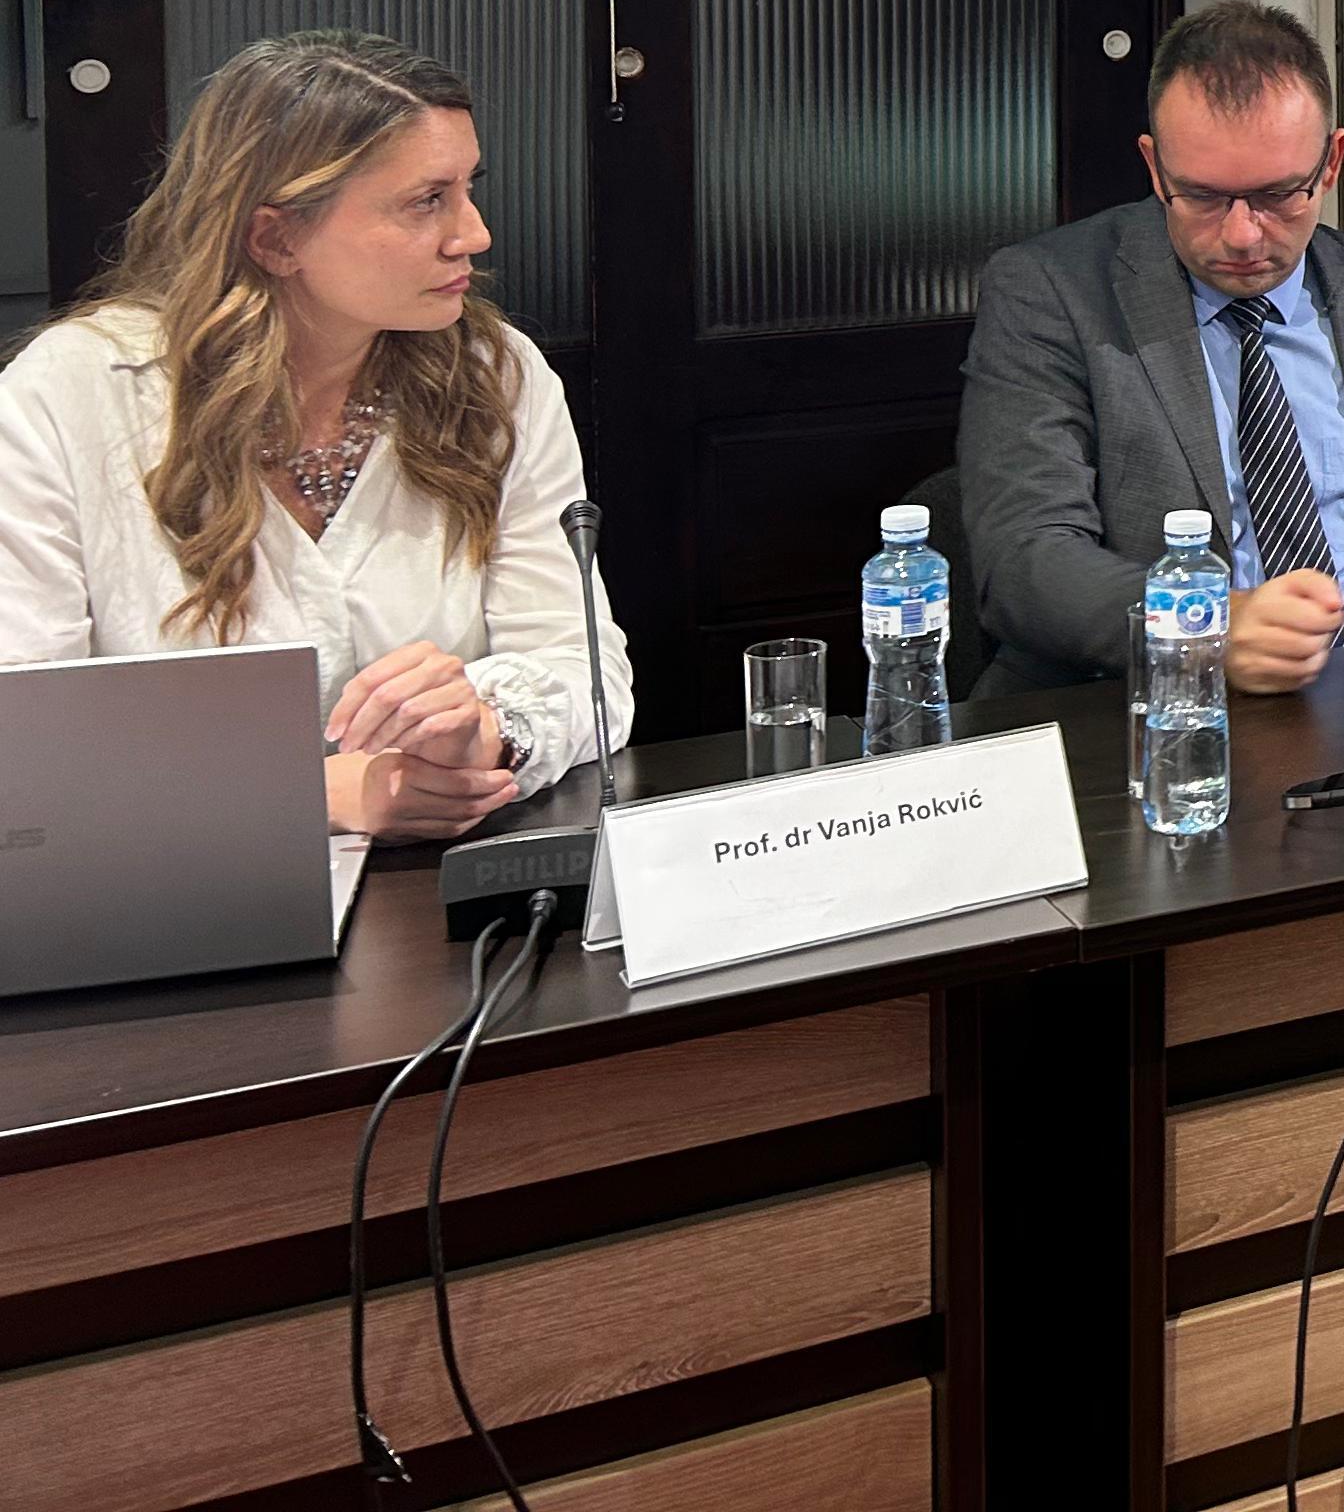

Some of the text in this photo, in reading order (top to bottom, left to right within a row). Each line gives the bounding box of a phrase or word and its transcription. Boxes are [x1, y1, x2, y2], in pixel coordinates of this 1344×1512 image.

[714, 787, 984, 863] Prof. dr Vanja Rokvić
[474, 851, 591, 886] PHILIP
